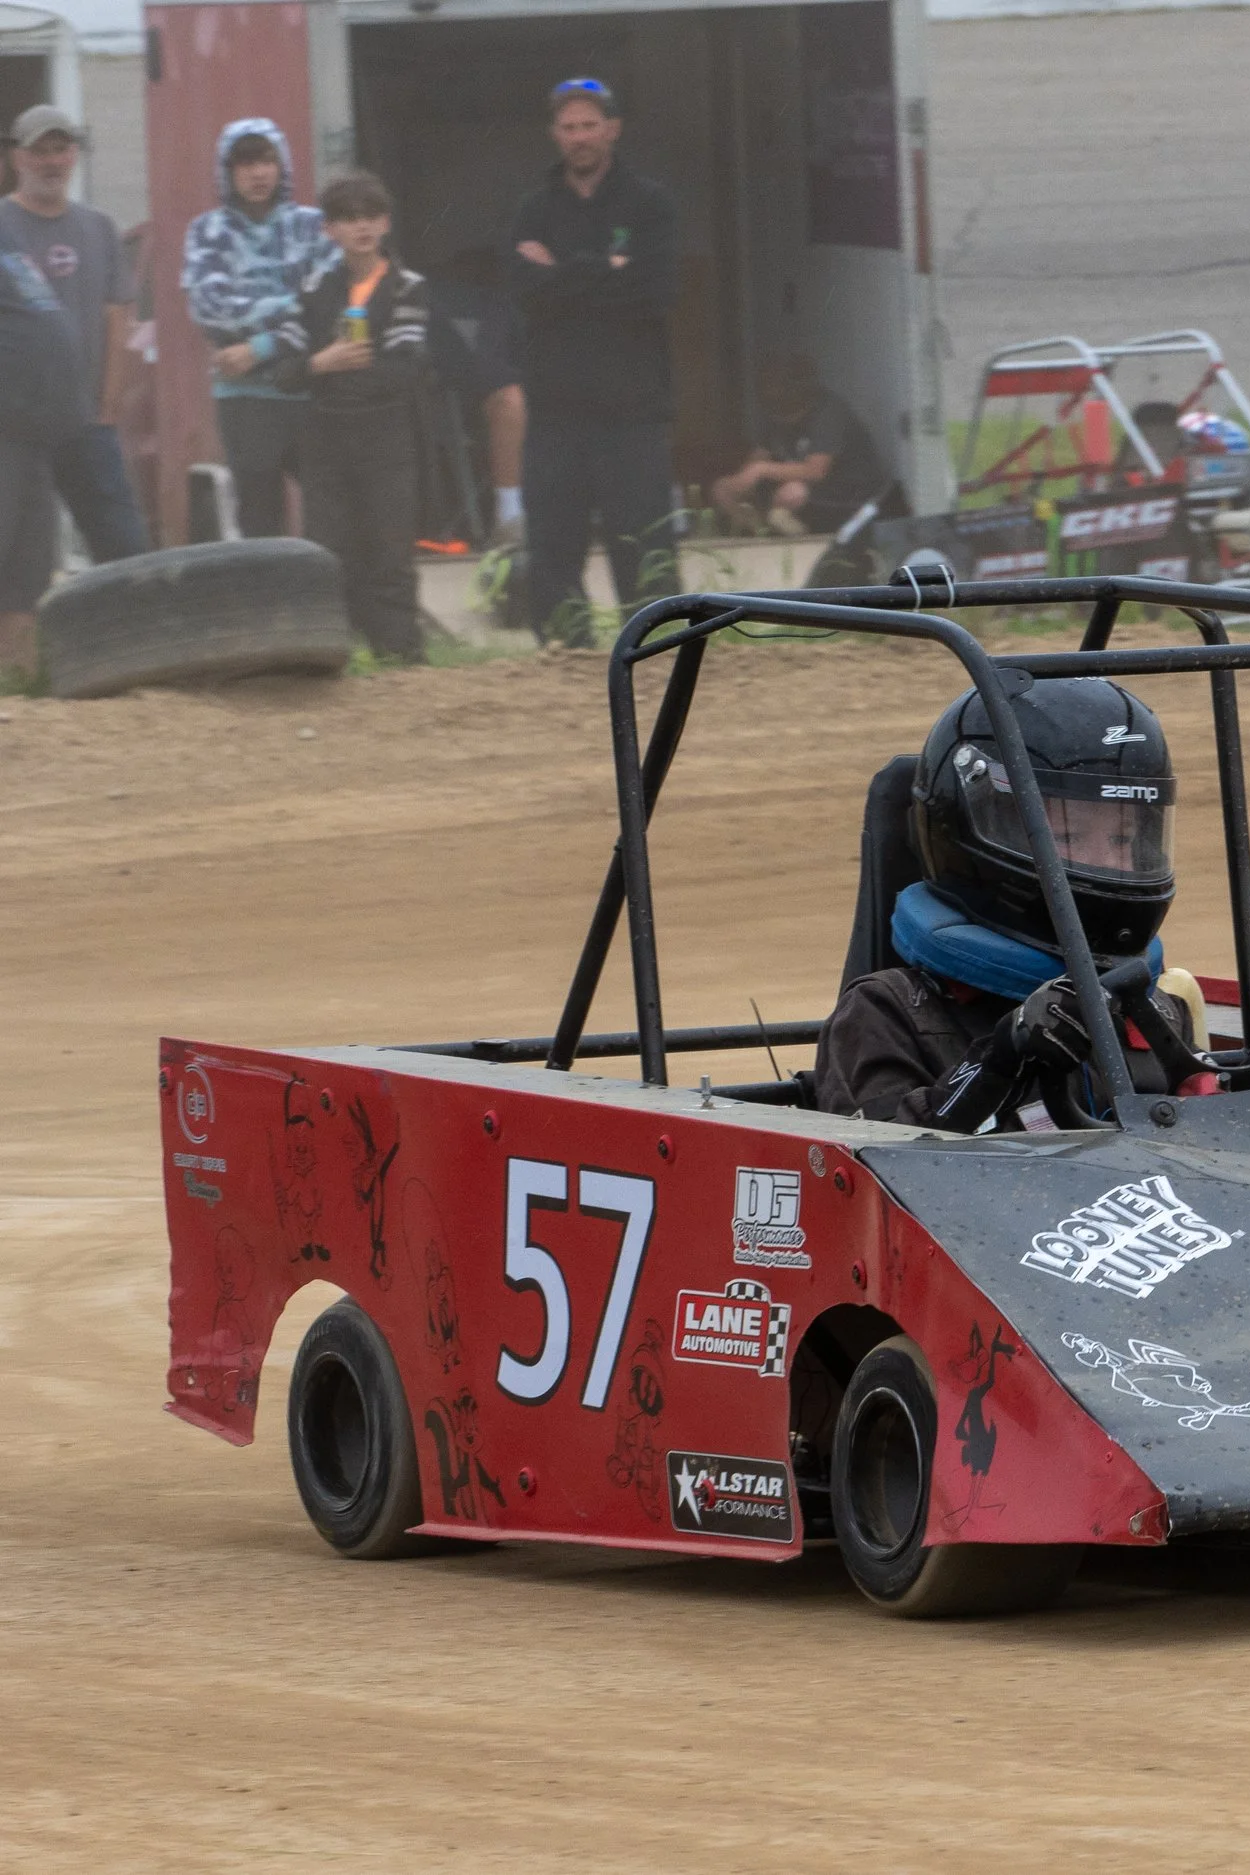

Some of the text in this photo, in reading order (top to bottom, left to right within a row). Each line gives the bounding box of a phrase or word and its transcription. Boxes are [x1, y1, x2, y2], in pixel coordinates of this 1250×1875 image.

[1101, 784, 1158, 803] zamp
[1019, 1175, 1193, 1284] LOONEY
[1083, 1208, 1233, 1299] TUNES
[496, 1155, 658, 1412] 57
[684, 1302, 763, 1337] LANE
[680, 1334, 761, 1358] AUTOMOTIVE
[697, 1496, 788, 1520] FORMANCE
